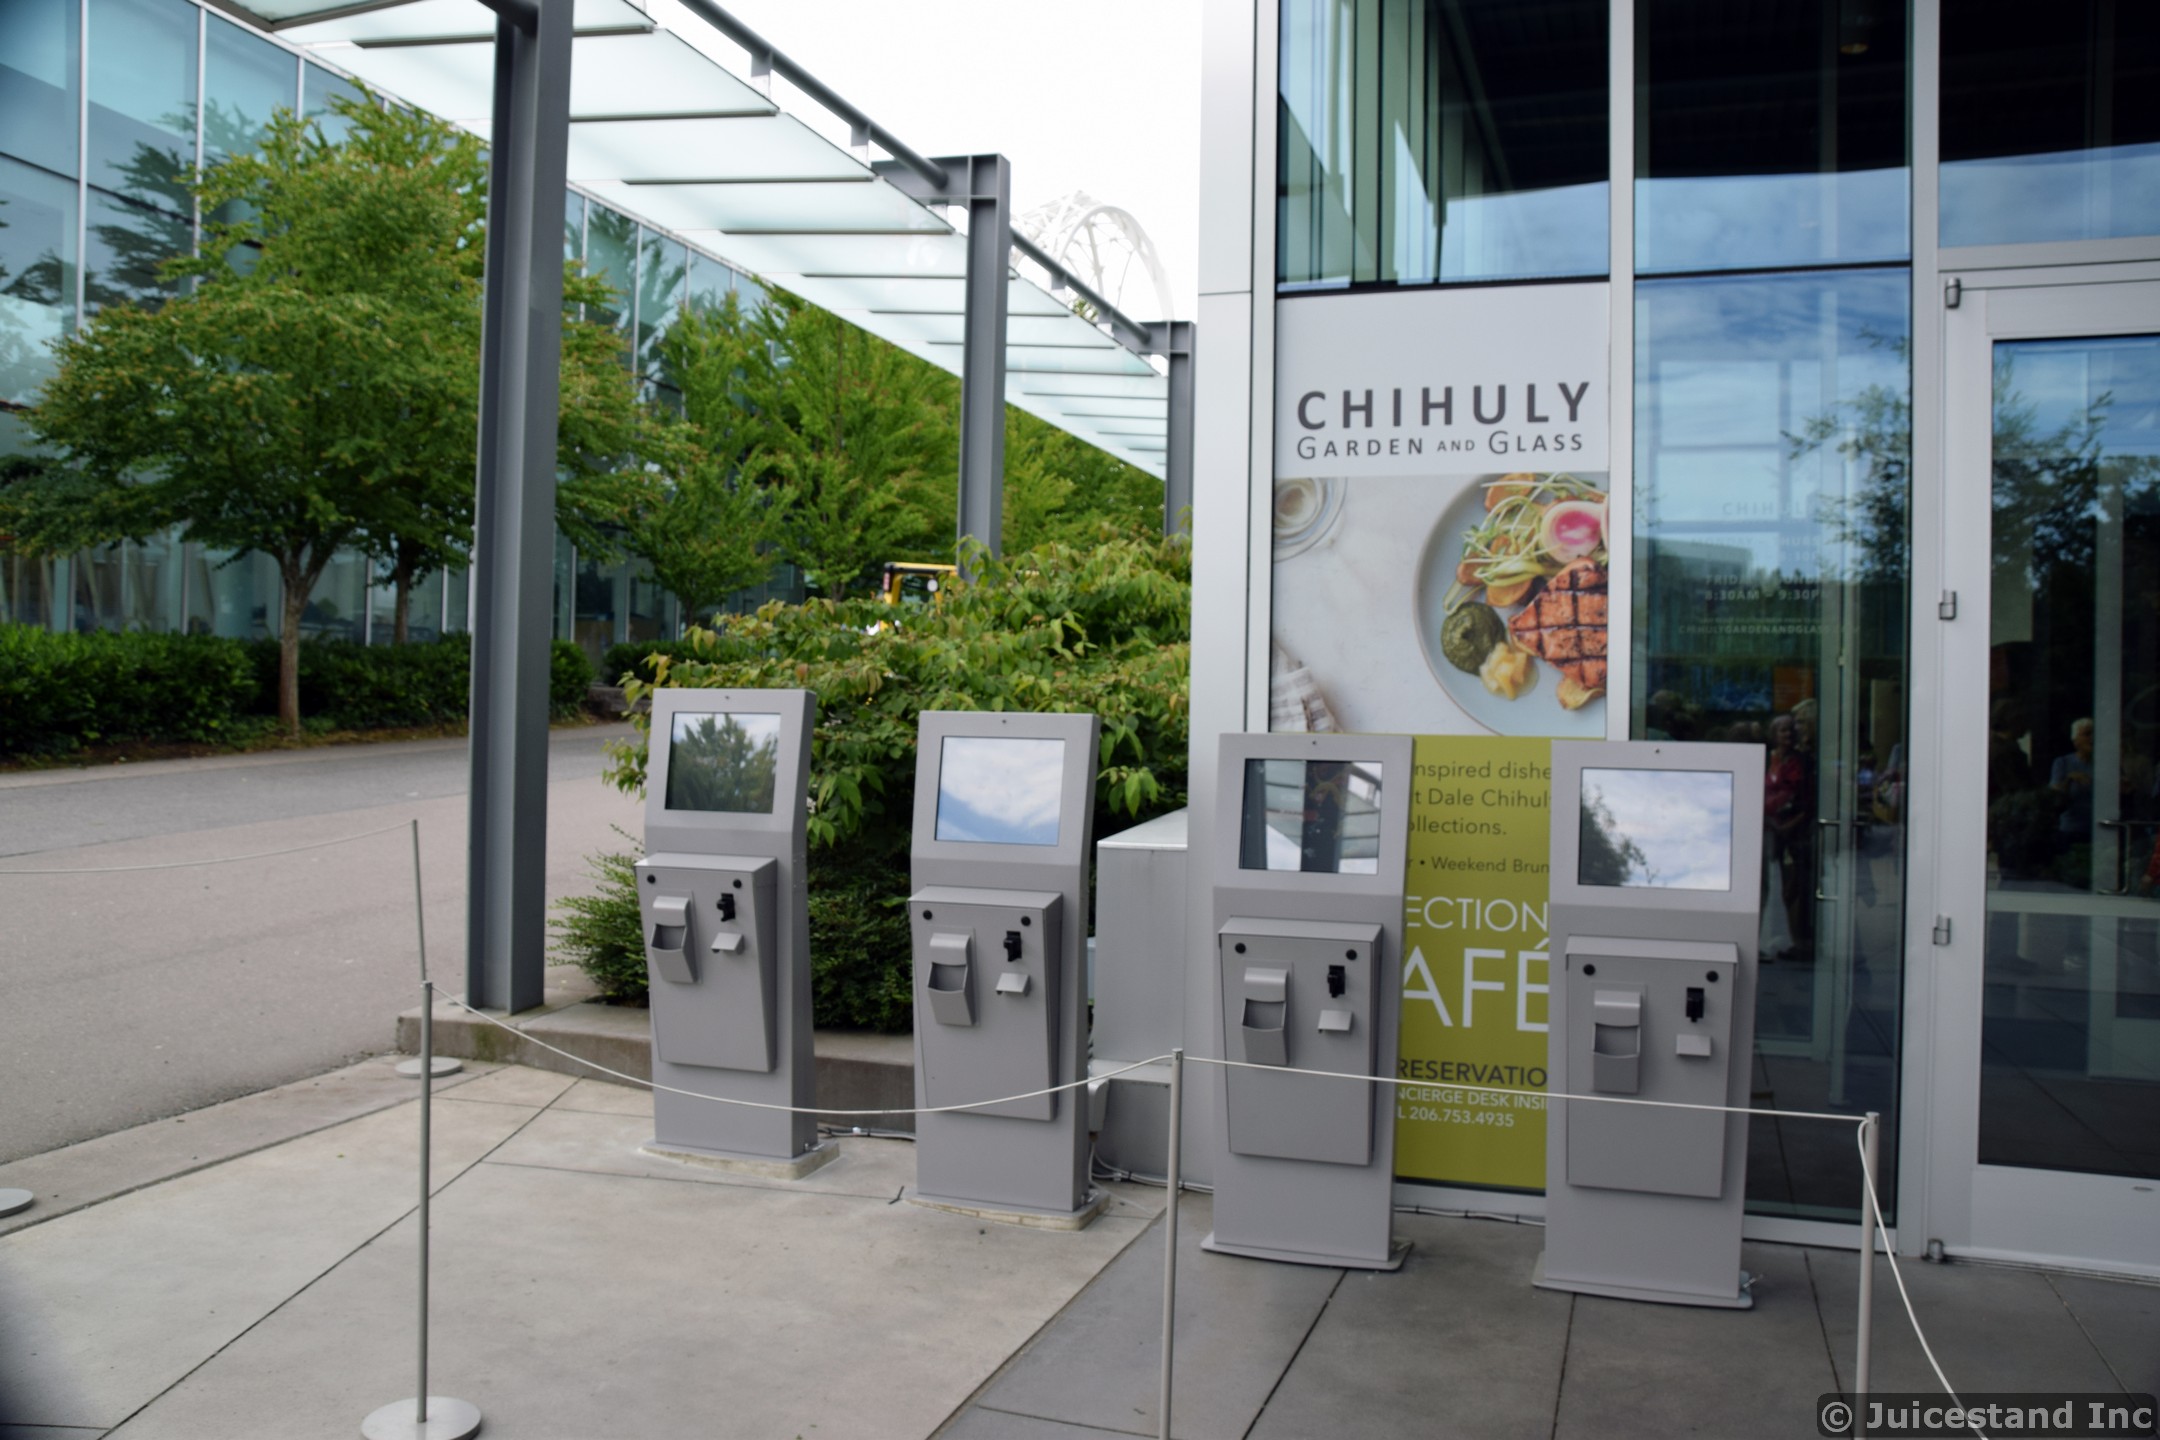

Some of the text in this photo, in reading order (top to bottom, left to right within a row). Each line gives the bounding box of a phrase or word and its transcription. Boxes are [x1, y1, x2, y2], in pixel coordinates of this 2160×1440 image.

[1297, 381, 1590, 430] CHIHULY
[1297, 430, 1582, 459] GARDEN AND GLASS
[1778, 589, 1824, 601] 9:30P
[1428, 788, 1474, 807] Dale
[1481, 788, 1552, 809] Chihul
[1431, 856, 1507, 873] Weekend
[1467, 1090, 1510, 1108] DESK
[1409, 1106, 1515, 1128] 206.753.4935
